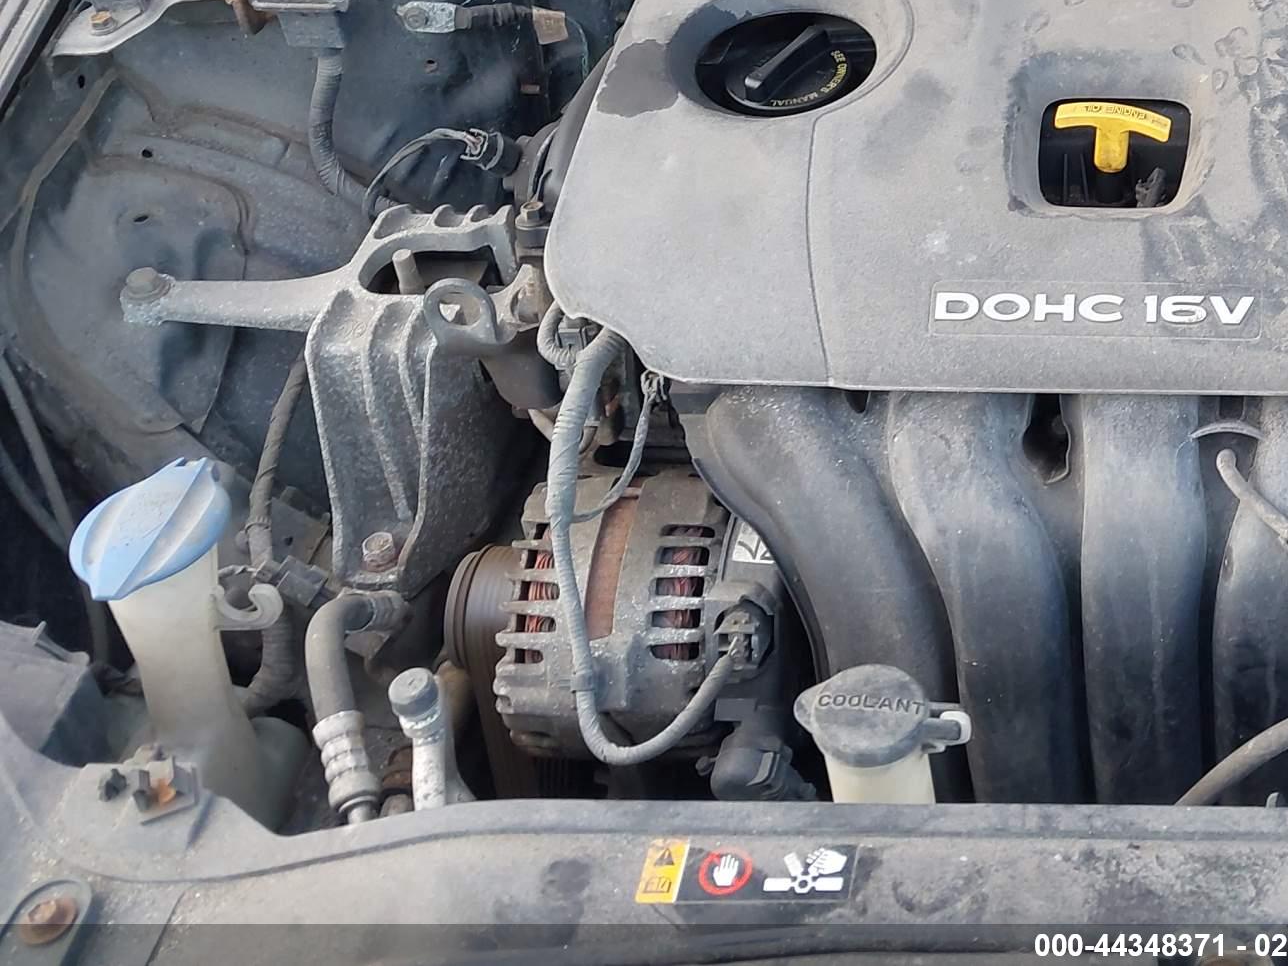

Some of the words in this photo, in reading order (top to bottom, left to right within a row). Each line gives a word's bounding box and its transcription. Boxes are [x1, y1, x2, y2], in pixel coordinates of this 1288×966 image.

[830, 49, 847, 63] SEE
[769, 91, 819, 107] MANUAL
[1104, 105, 1147, 121] ENGINE
[934, 291, 1124, 323] DOHC
[1144, 294, 1256, 325] 16V
[818, 693, 926, 715] COOLANT
